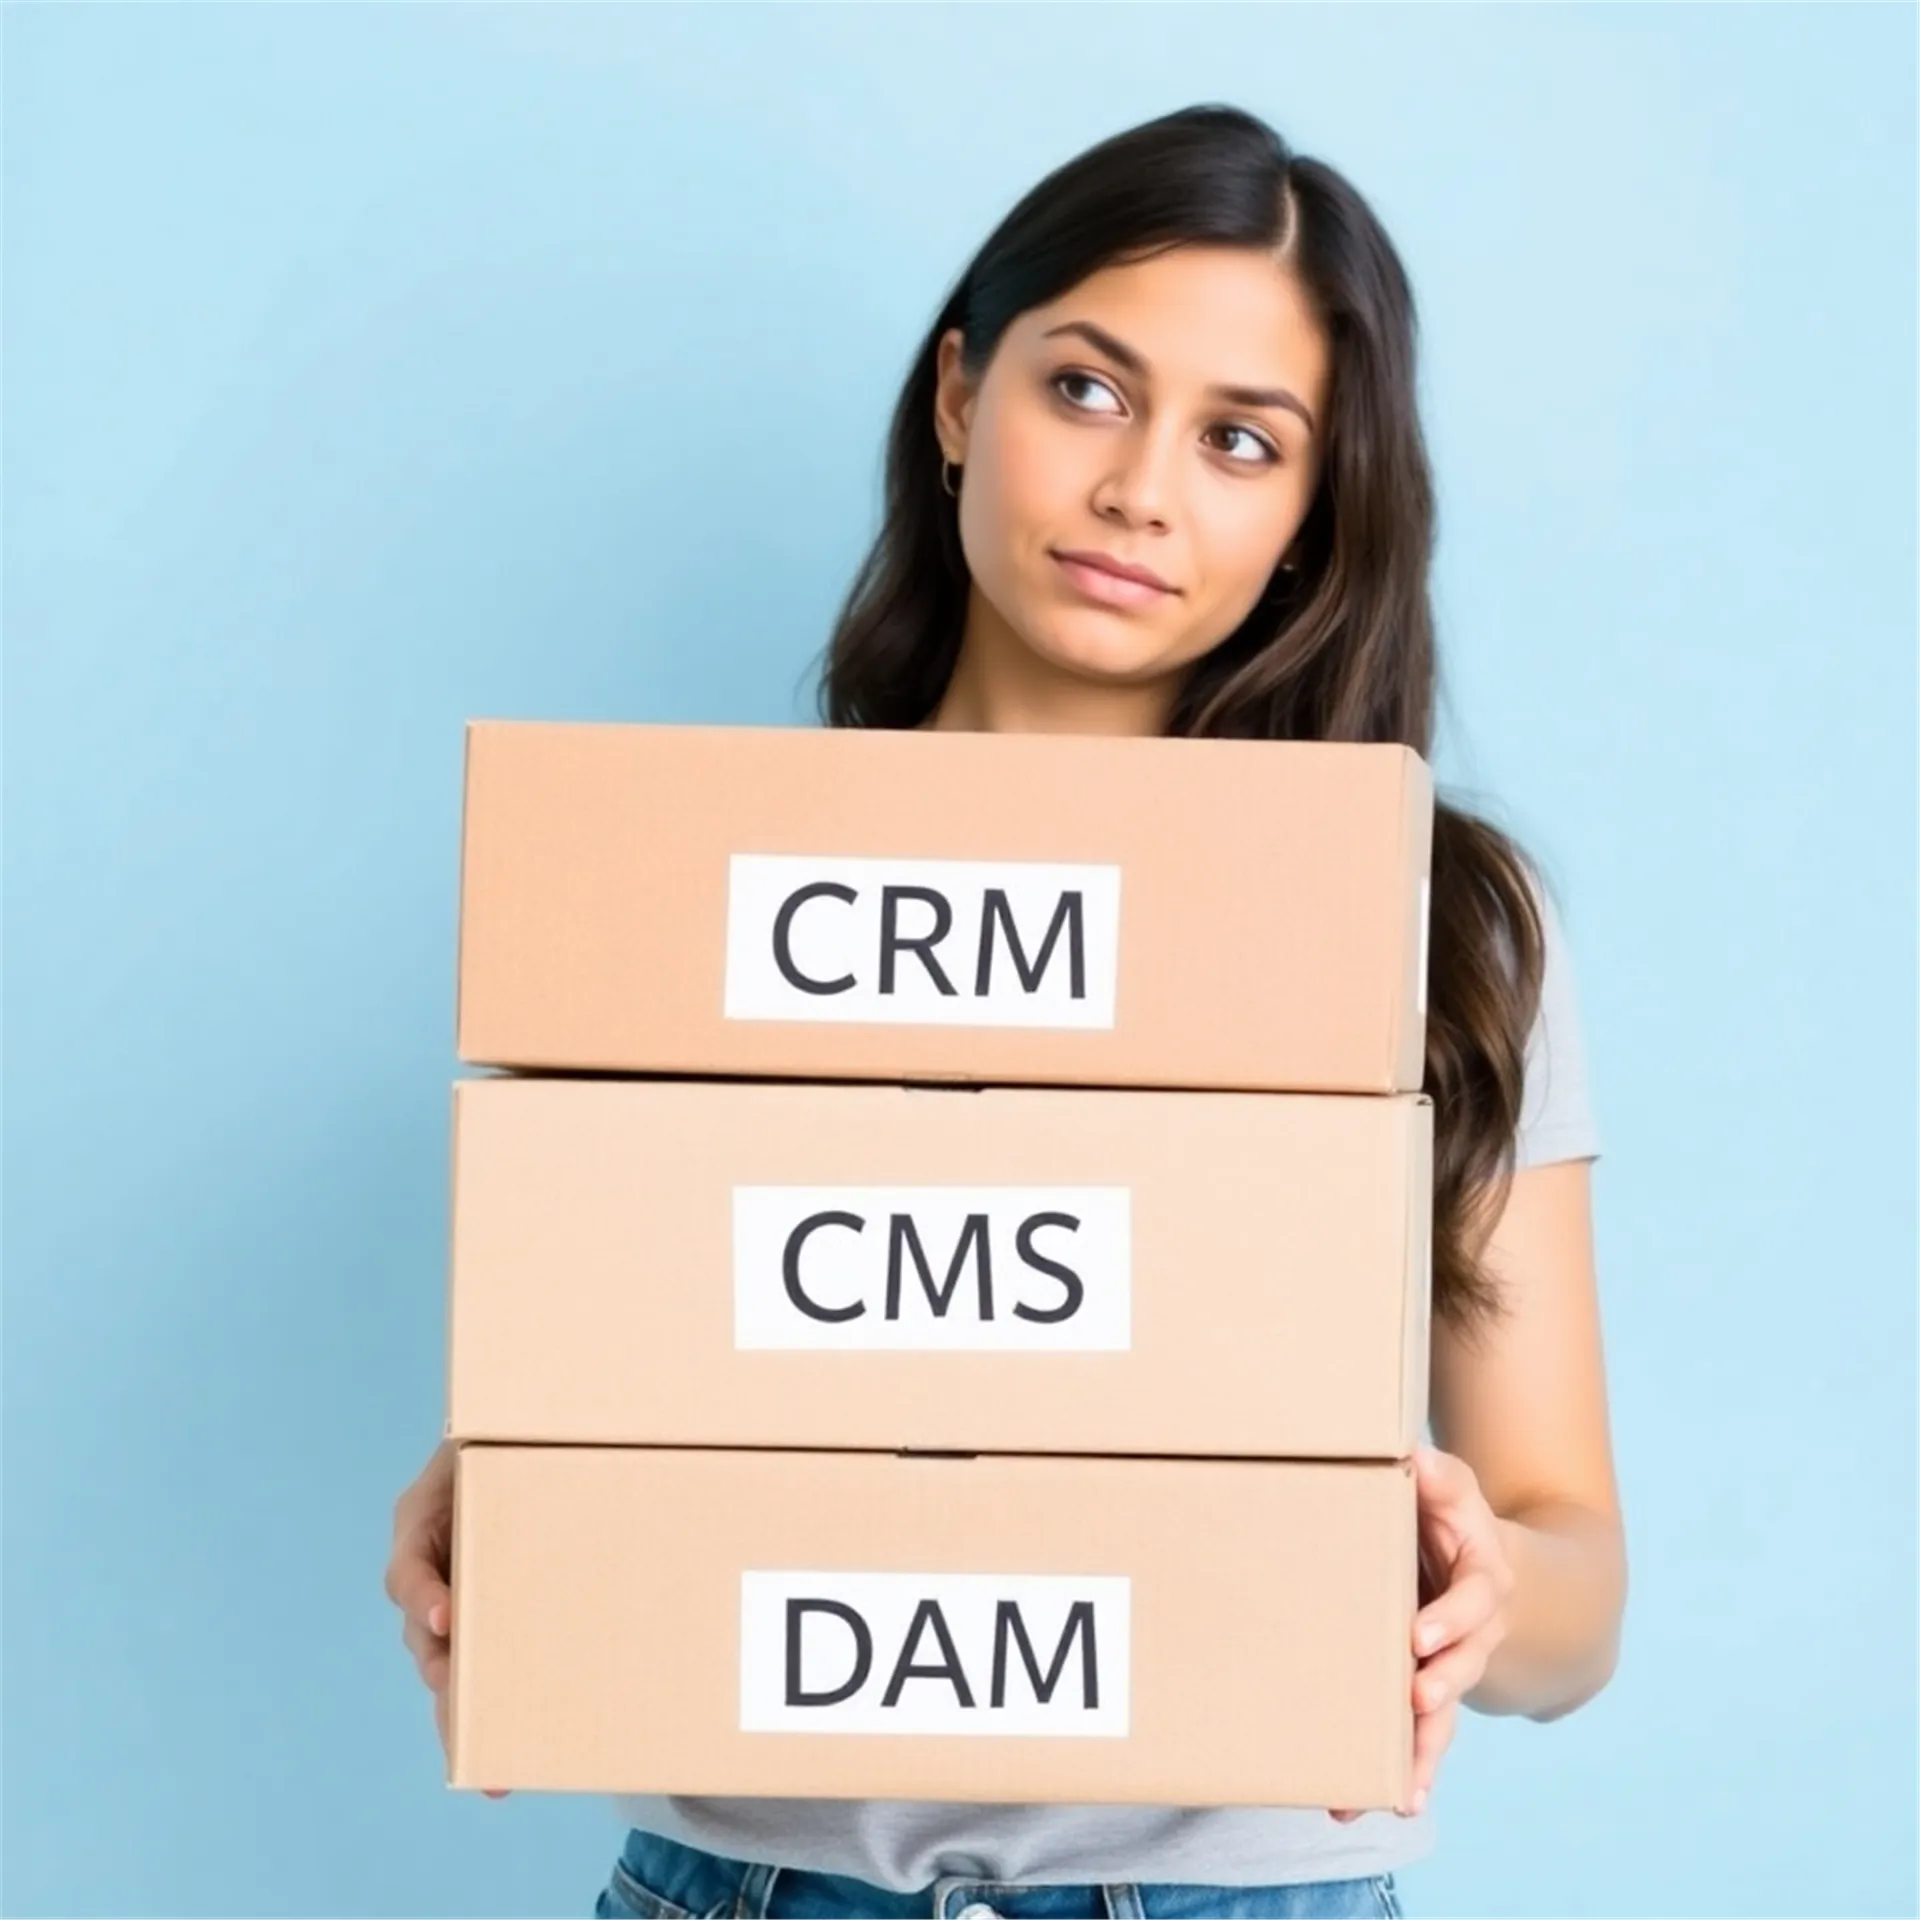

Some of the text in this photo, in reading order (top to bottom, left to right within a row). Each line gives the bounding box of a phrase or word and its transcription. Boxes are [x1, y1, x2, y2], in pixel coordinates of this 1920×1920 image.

[771, 881, 1086, 999] CRM
[781, 1210, 1085, 1324] CMS
[784, 1597, 1100, 1709] DAM
